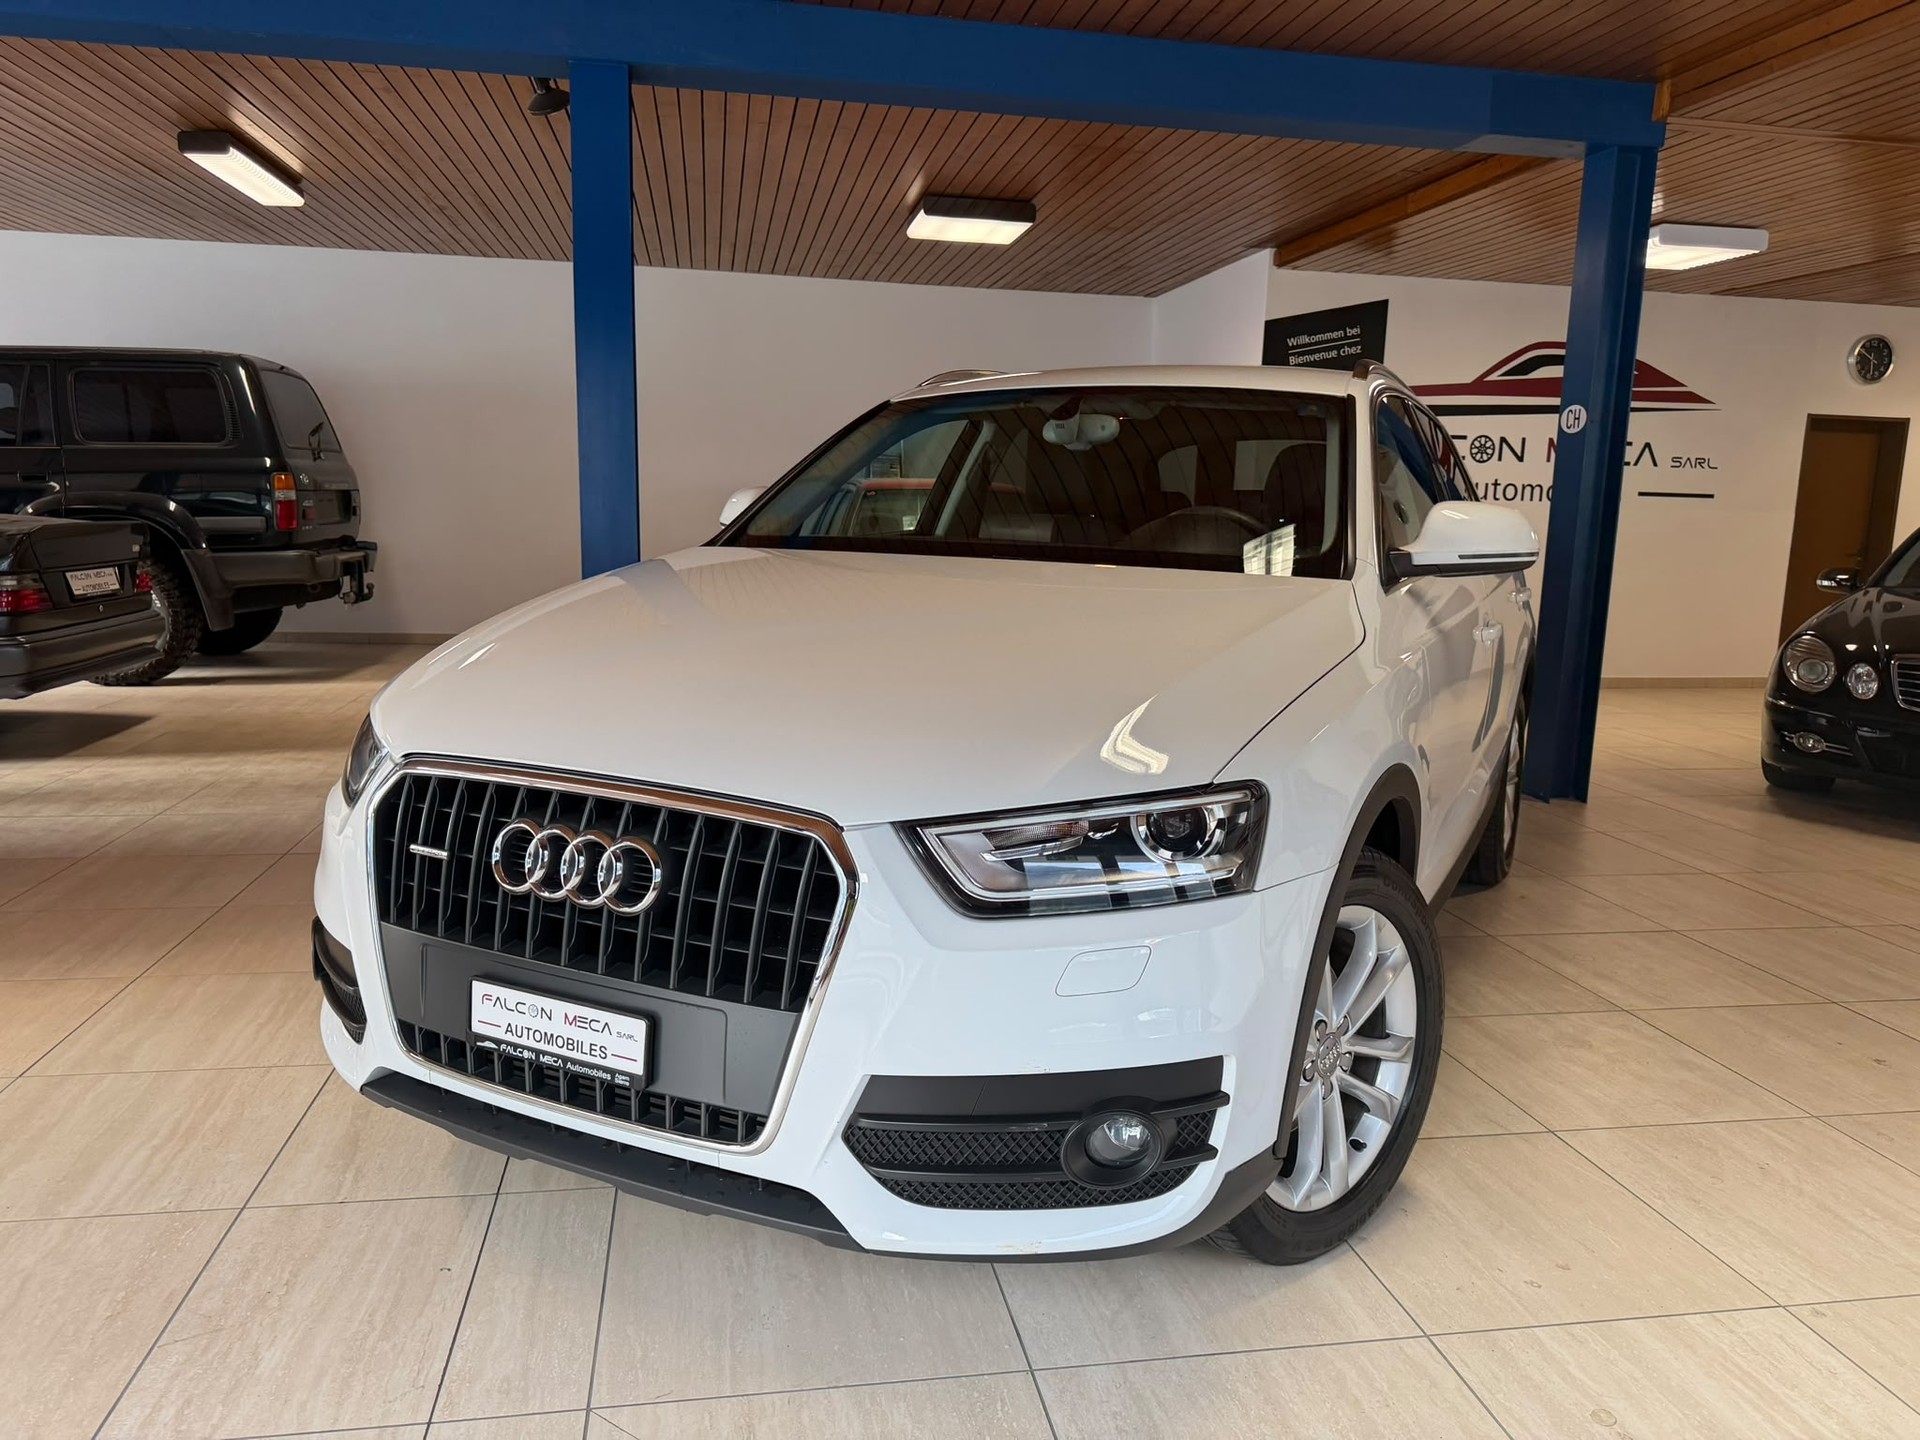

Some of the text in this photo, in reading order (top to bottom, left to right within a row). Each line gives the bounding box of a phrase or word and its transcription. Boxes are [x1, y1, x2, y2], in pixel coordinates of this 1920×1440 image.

[1287, 325, 1360, 346] Willkommen bei
[1289, 345, 1362, 365] Bienvenue chez
[1566, 408, 1581, 429] CH
[1670, 456, 1718, 470] SARL
[482, 993, 638, 1042] FALCON MECA SARL
[505, 1022, 608, 1060] AUTOMOBILES
[500, 1043, 611, 1080] FALCON MECA Automobiles
